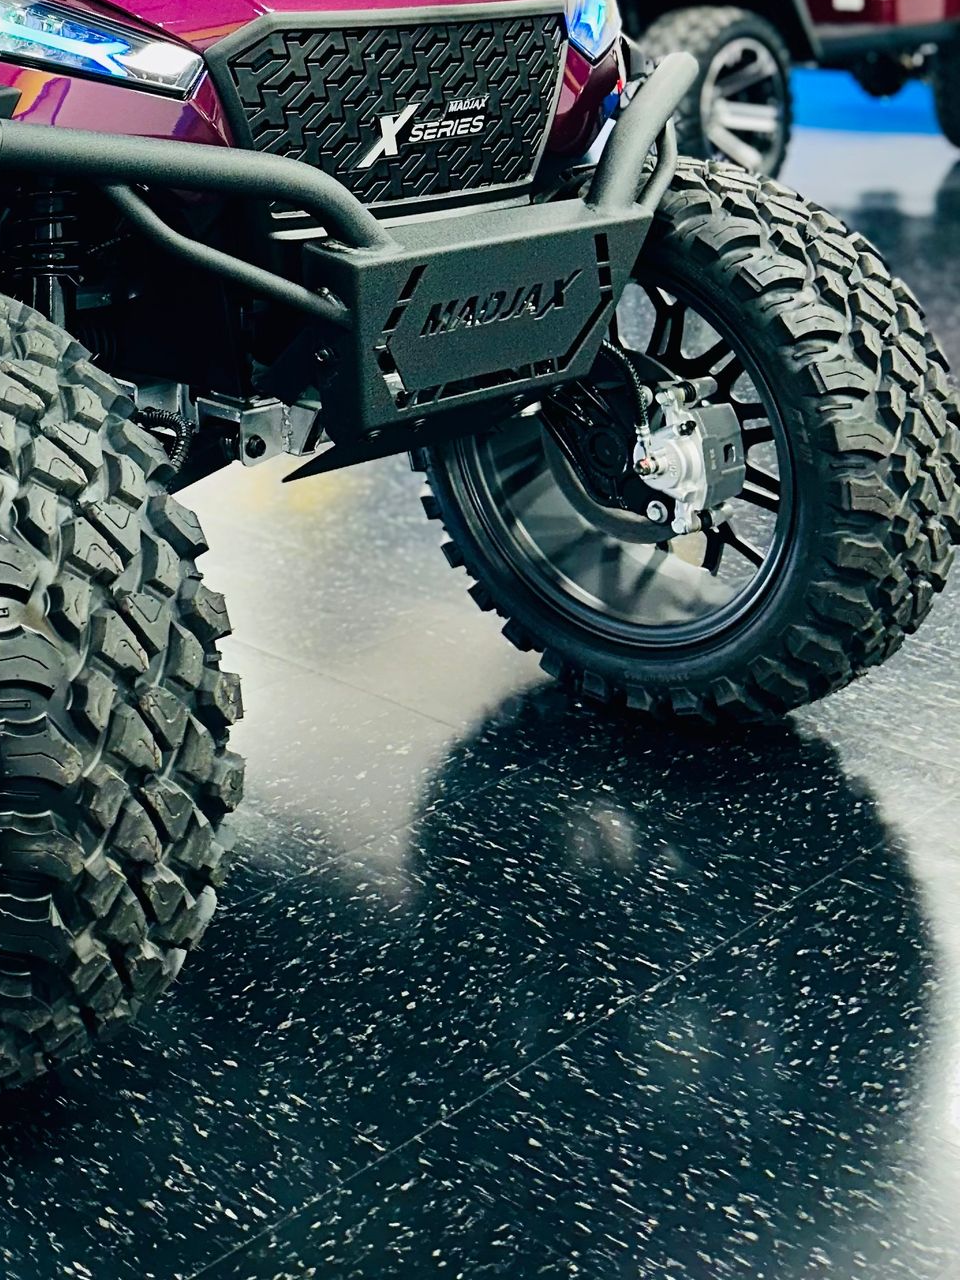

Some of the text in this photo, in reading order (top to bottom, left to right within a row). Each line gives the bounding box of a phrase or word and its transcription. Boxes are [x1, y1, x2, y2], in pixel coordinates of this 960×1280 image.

[356, 102, 485, 168] X SERIES
[448, 93, 489, 113] MADJAX
[419, 269, 583, 338] MADJAX
